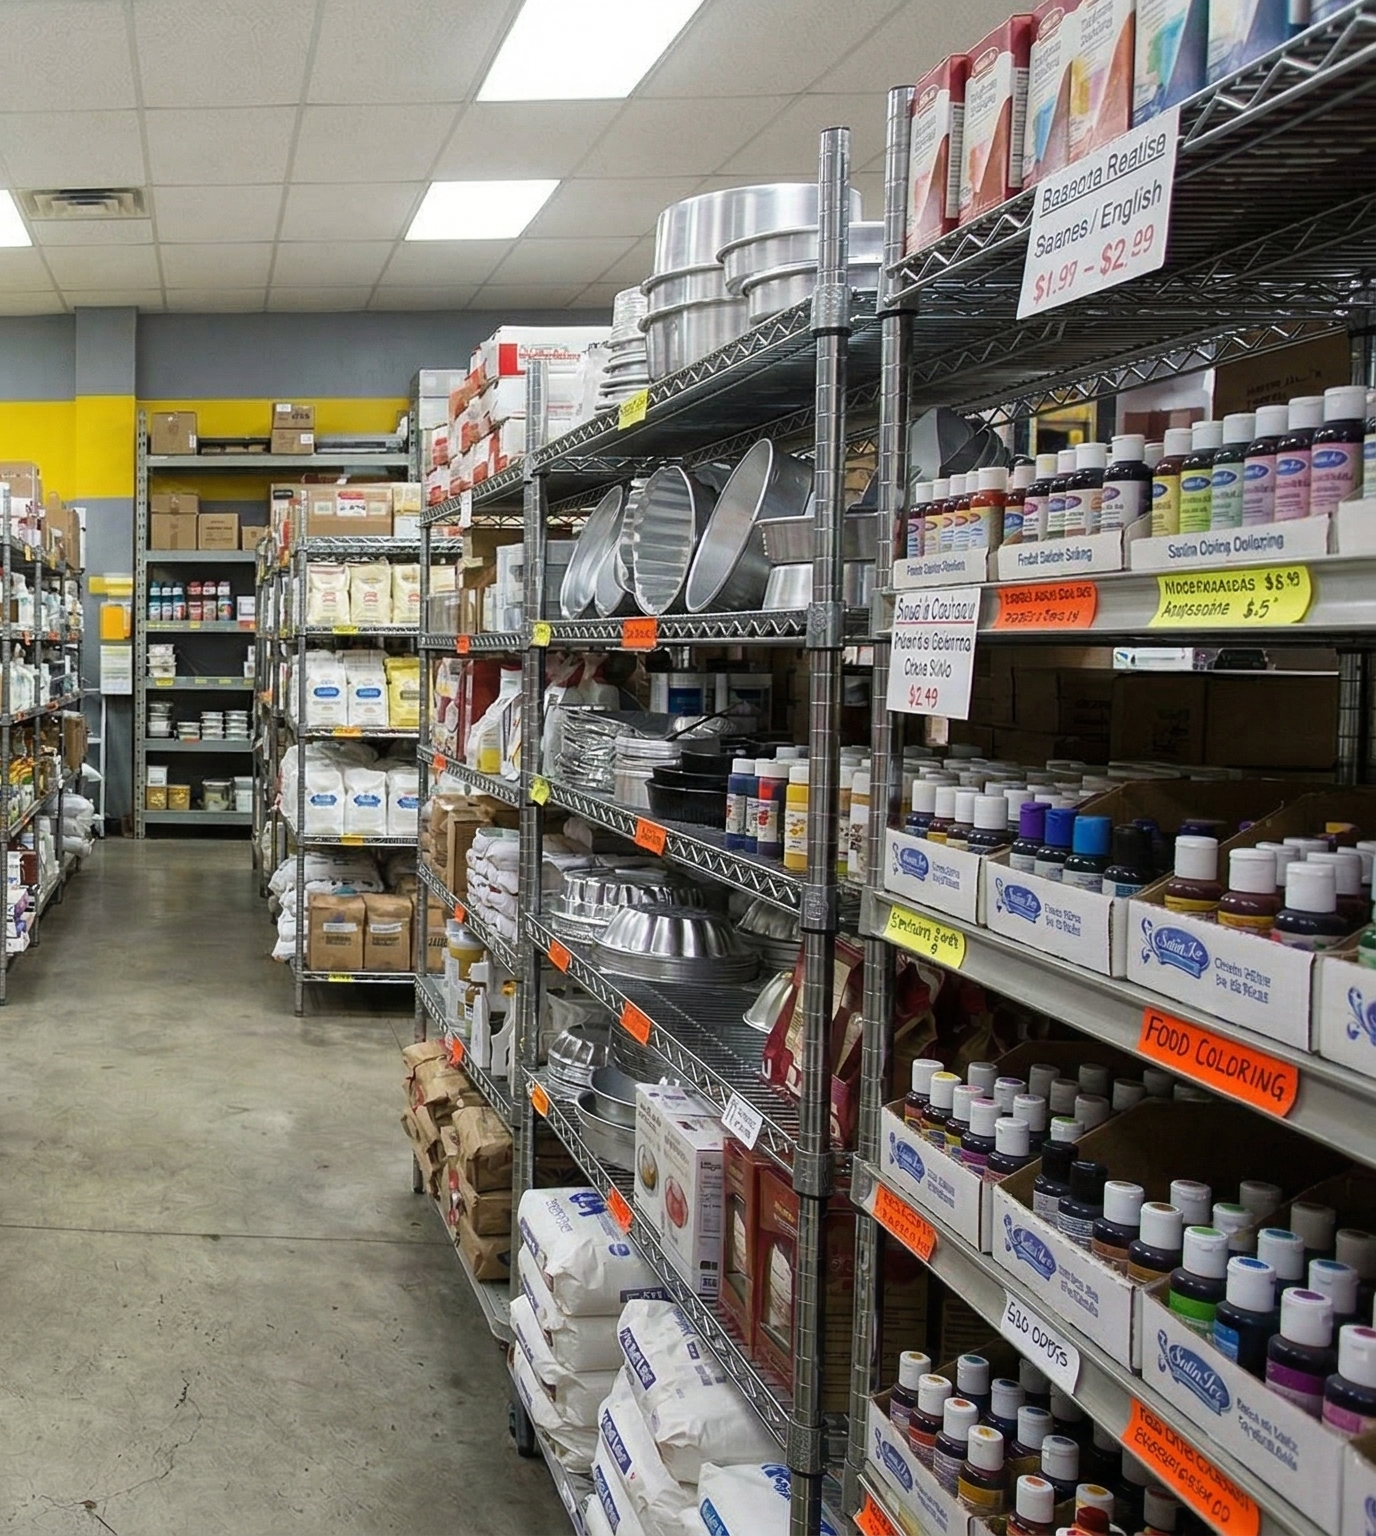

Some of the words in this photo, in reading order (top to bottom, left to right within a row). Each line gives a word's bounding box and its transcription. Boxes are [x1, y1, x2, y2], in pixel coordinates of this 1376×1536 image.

[1100, 179, 1163, 230] English
[1145, 1016, 1190, 1056] FOOD
[1195, 1039, 1287, 1102] COLORING
